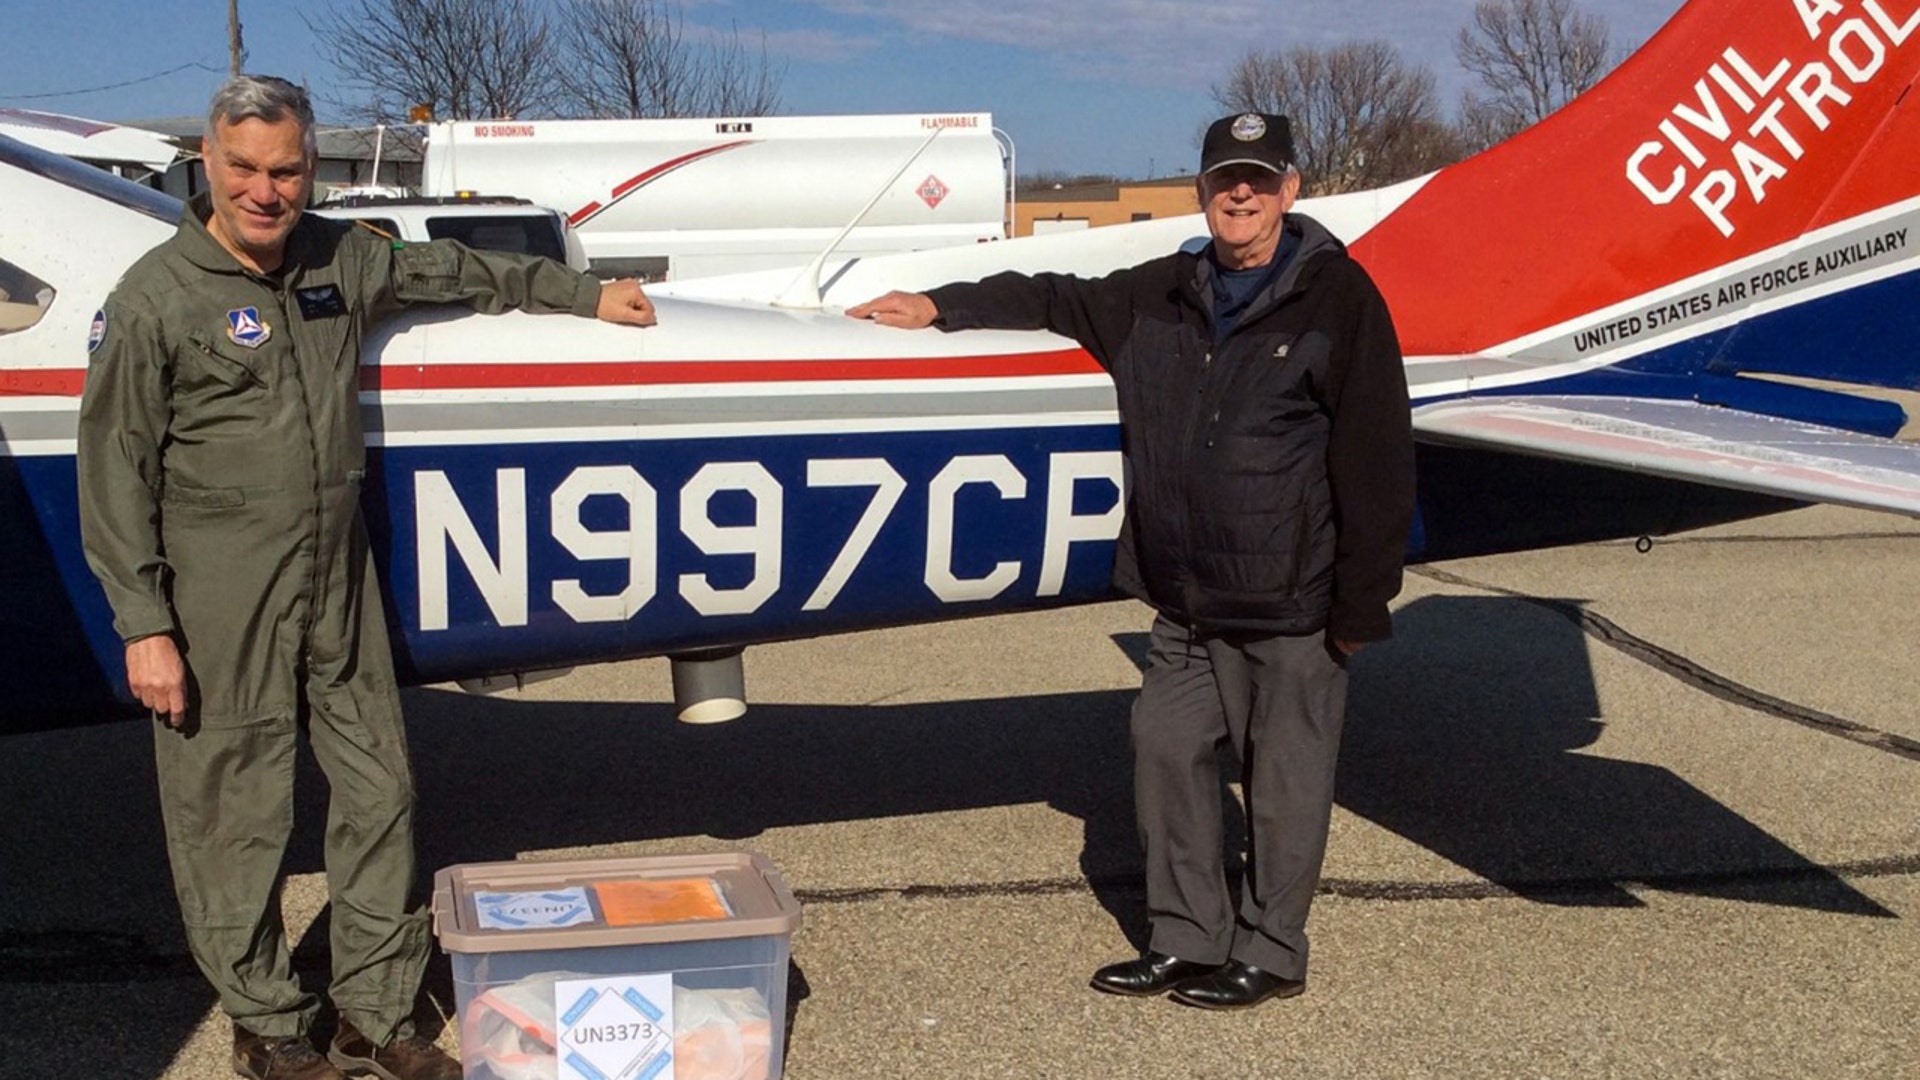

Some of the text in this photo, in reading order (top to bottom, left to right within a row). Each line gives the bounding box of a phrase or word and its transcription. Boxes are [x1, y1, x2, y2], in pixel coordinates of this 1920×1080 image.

[475, 125, 535, 137] NO SMOKING
[921, 116, 979, 129] FLAMMABLE
[1626, 46, 1792, 205] CIVIL
[1689, 0, 1920, 239] PATROL
[1574, 227, 1908, 353] UNITED STATES AIR FORCE AUXILIARY
[413, 450, 1126, 631] N997CP
[573, 1022, 653, 1045] UN3373
